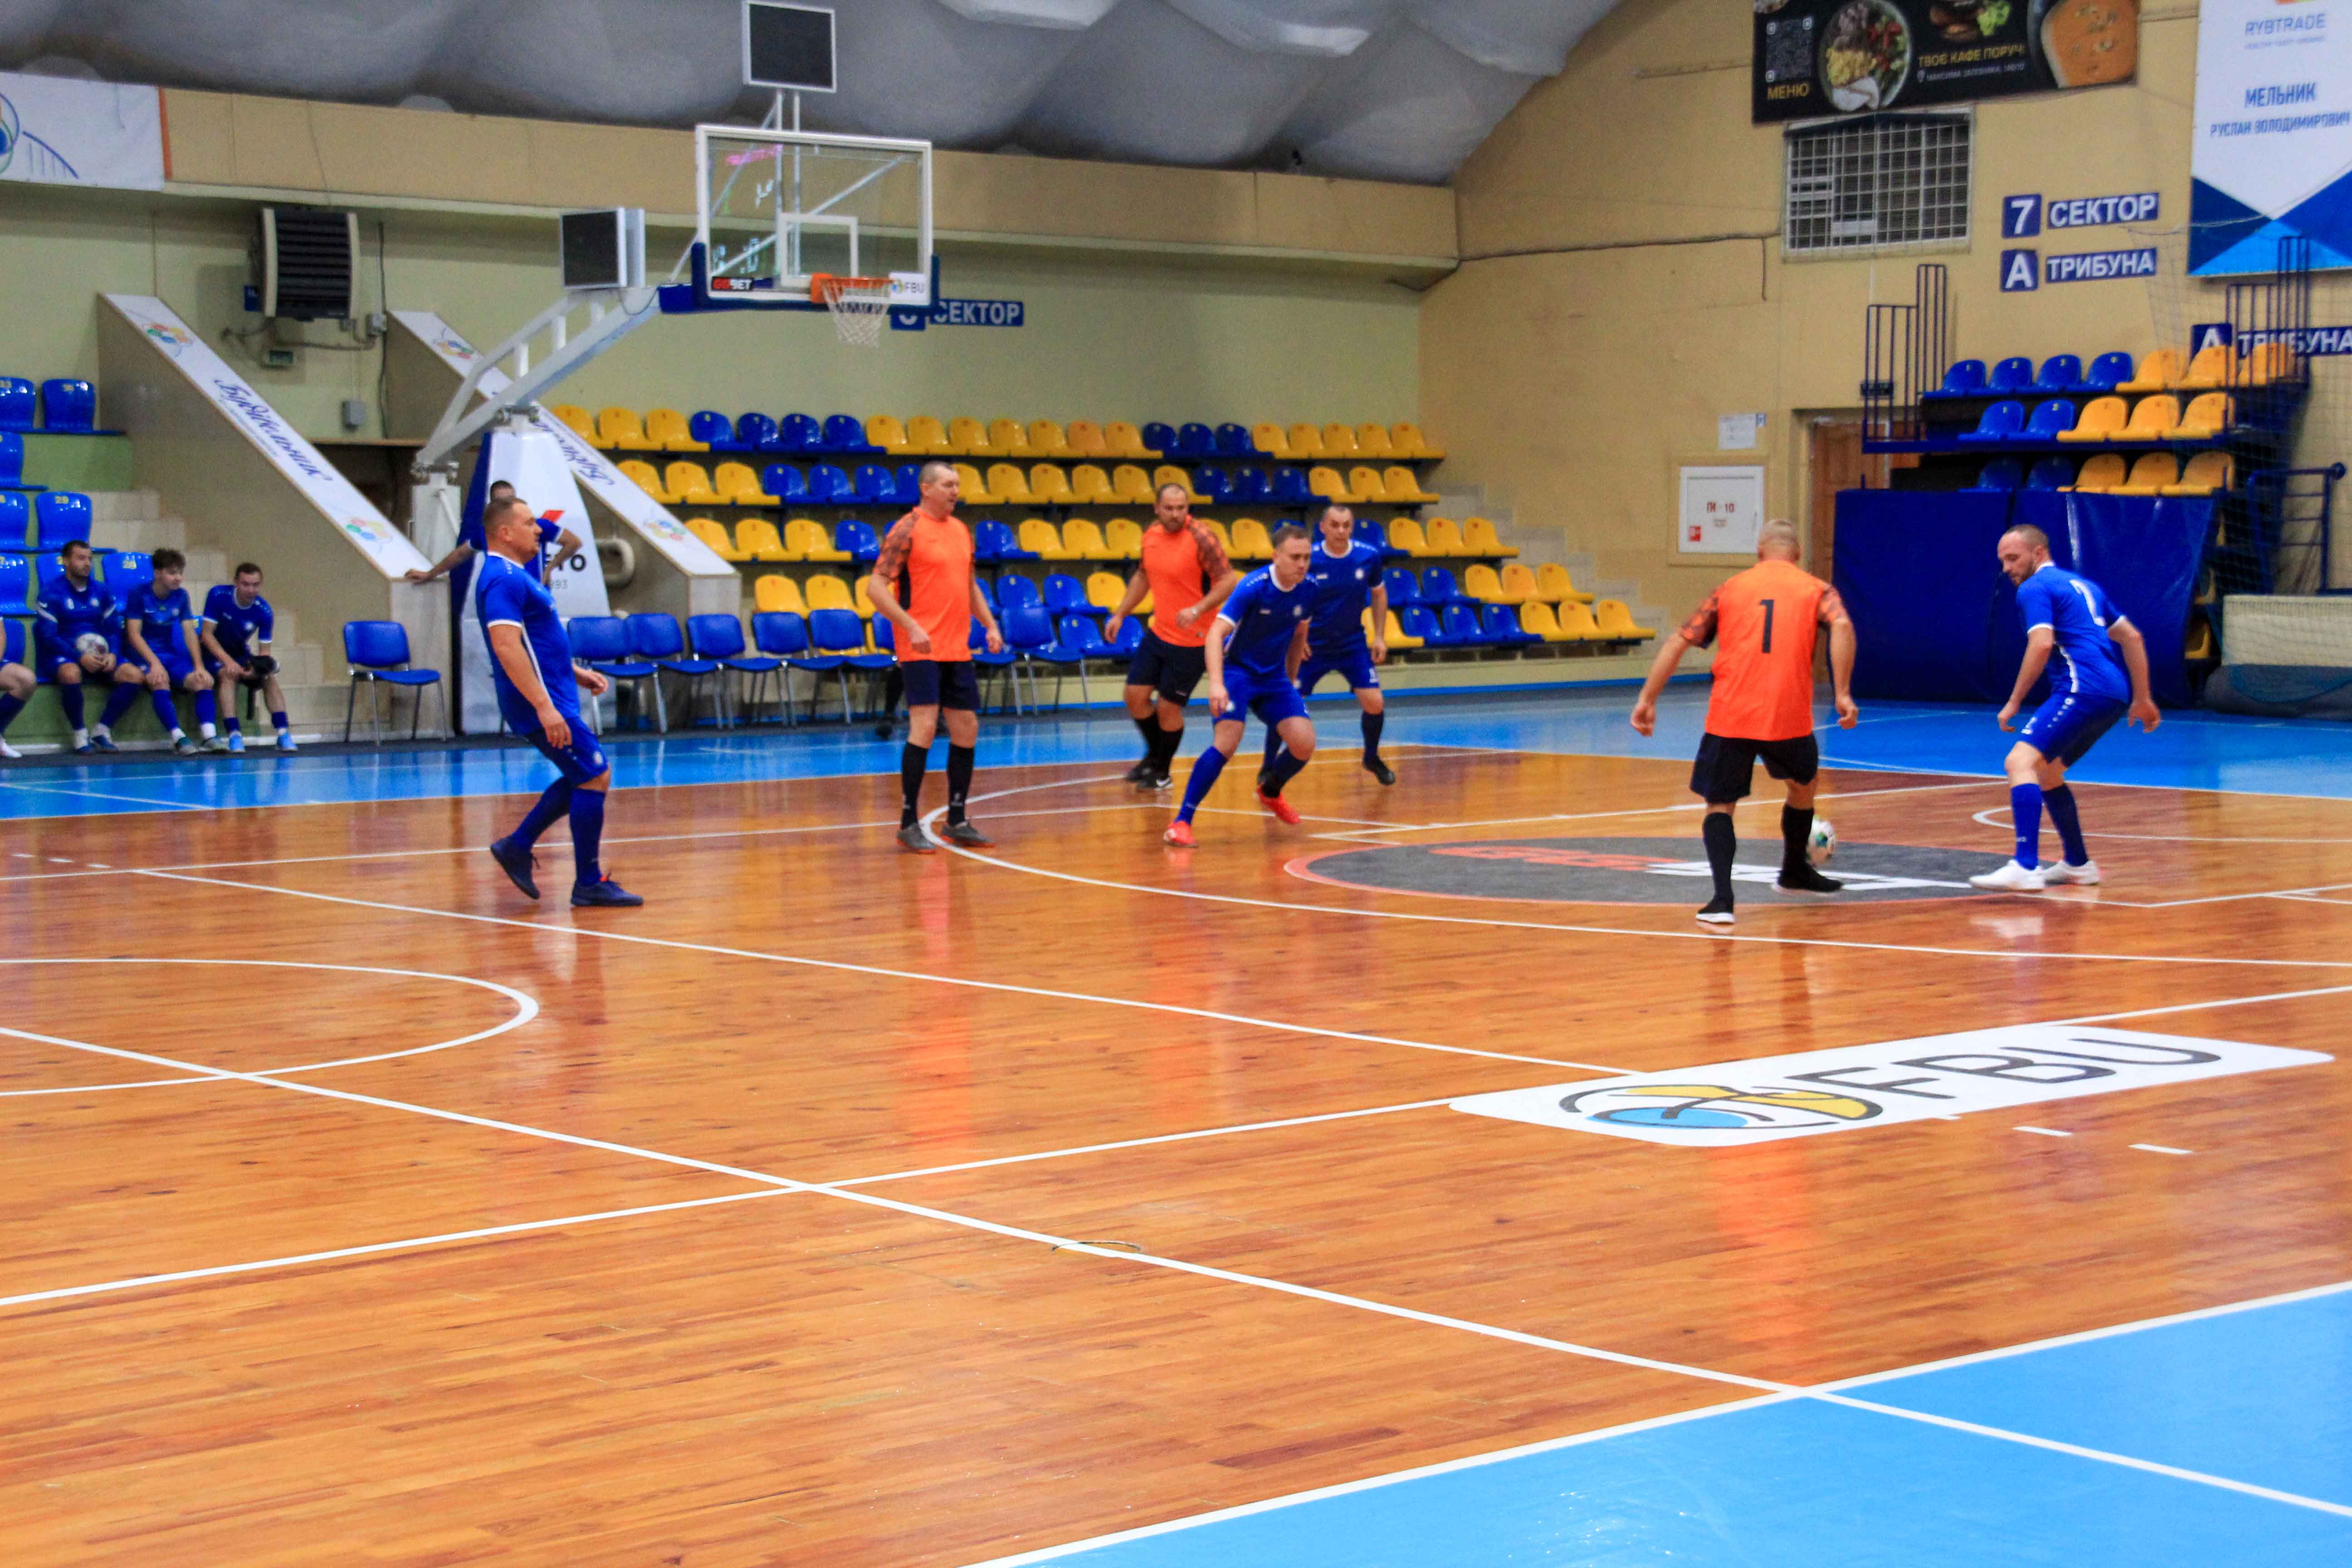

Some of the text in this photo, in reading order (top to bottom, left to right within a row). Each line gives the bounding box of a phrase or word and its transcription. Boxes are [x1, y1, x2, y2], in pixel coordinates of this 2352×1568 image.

[2245, 14, 2325, 35] RYBTRADE
[1918, 54, 1947, 67] ТВОЄ
[1950, 49, 1981, 63] КАФЕ
[1768, 83, 1808, 99] МЕНЮ
[2244, 82, 2316, 108] МЕЛЬНИК
[2210, 111, 2351, 137] РУСЛАН ВОЛОДИМИРОВИЧ
[2011, 195, 2156, 234] 7 СЕКТОР
[2004, 251, 2154, 289] А ТРИБУНА
[905, 282, 924, 293] FBU
[1725, 503, 1735, 513] 10
[1759, 599, 1775, 654] 1
[1783, 1038, 2221, 1100] FBU
